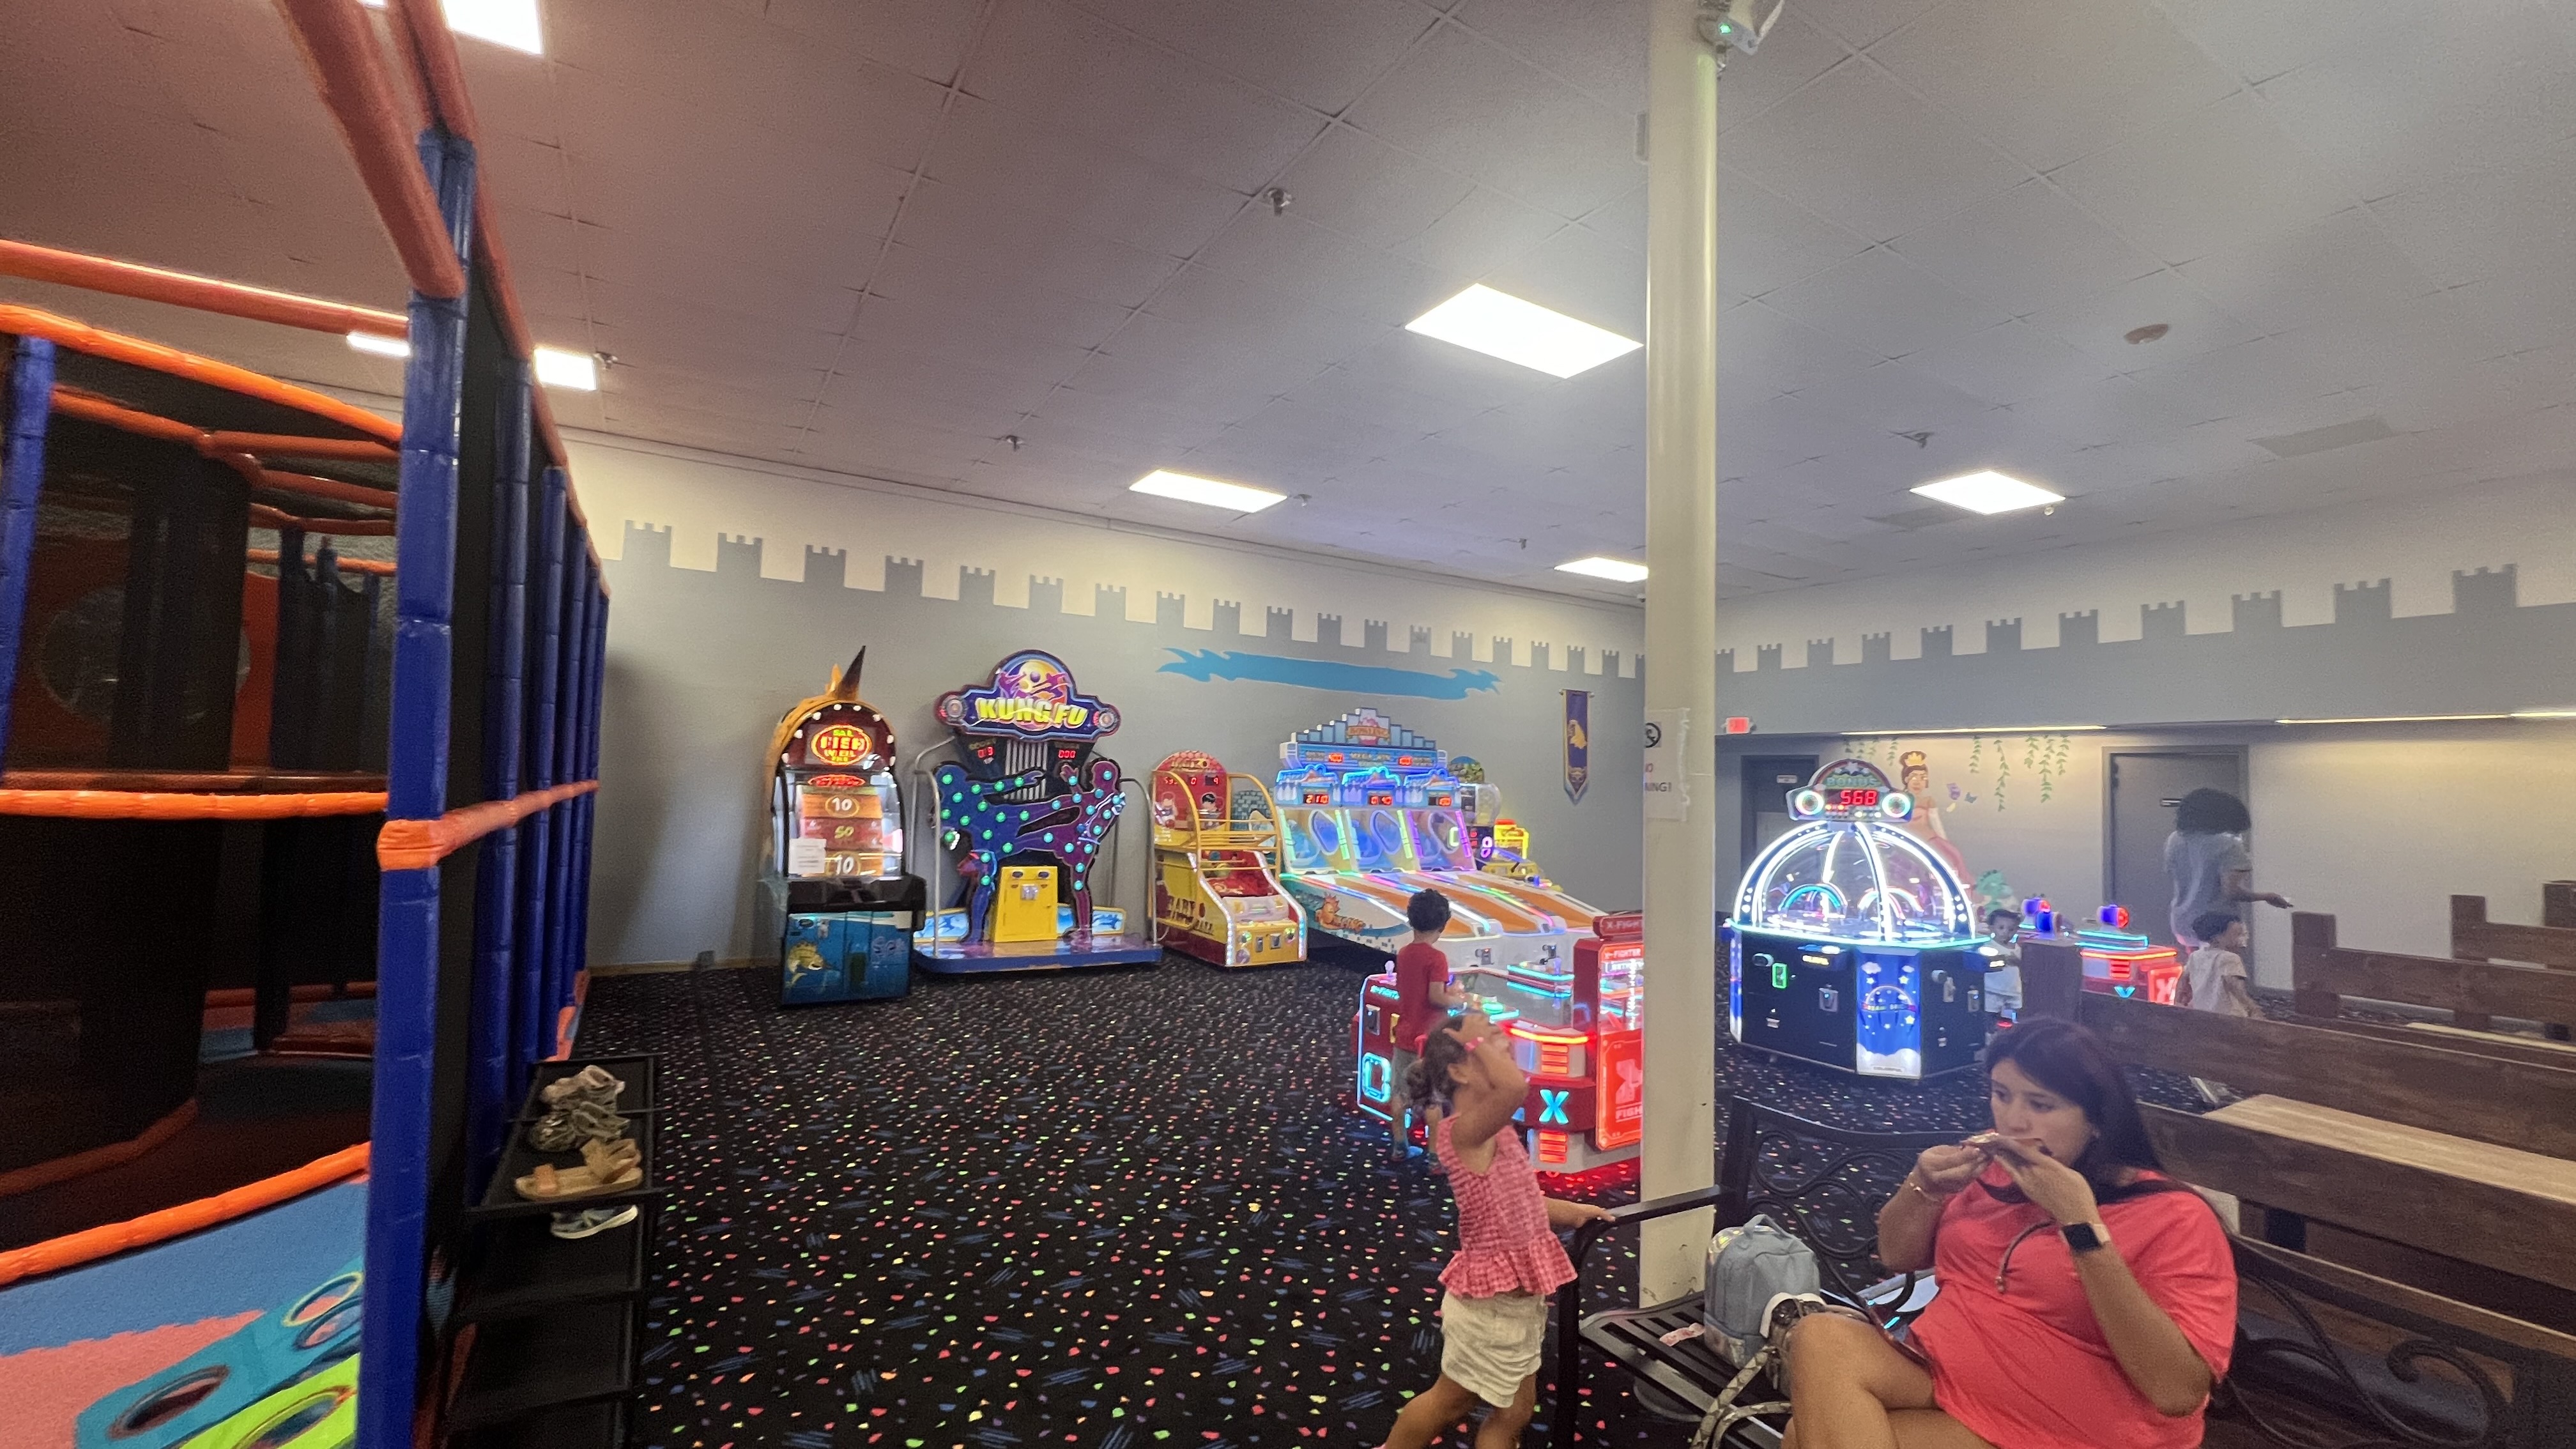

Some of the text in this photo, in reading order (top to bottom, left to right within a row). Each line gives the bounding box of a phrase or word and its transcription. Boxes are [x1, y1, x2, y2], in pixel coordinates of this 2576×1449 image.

[976, 697, 1087, 727] KUNG FU
[1826, 777, 1877, 786] BONUS
[832, 797, 852, 811] 10
[1840, 790, 1878, 805] 568
[834, 855, 854, 875] 10
[1538, 1089, 1569, 1124] X
